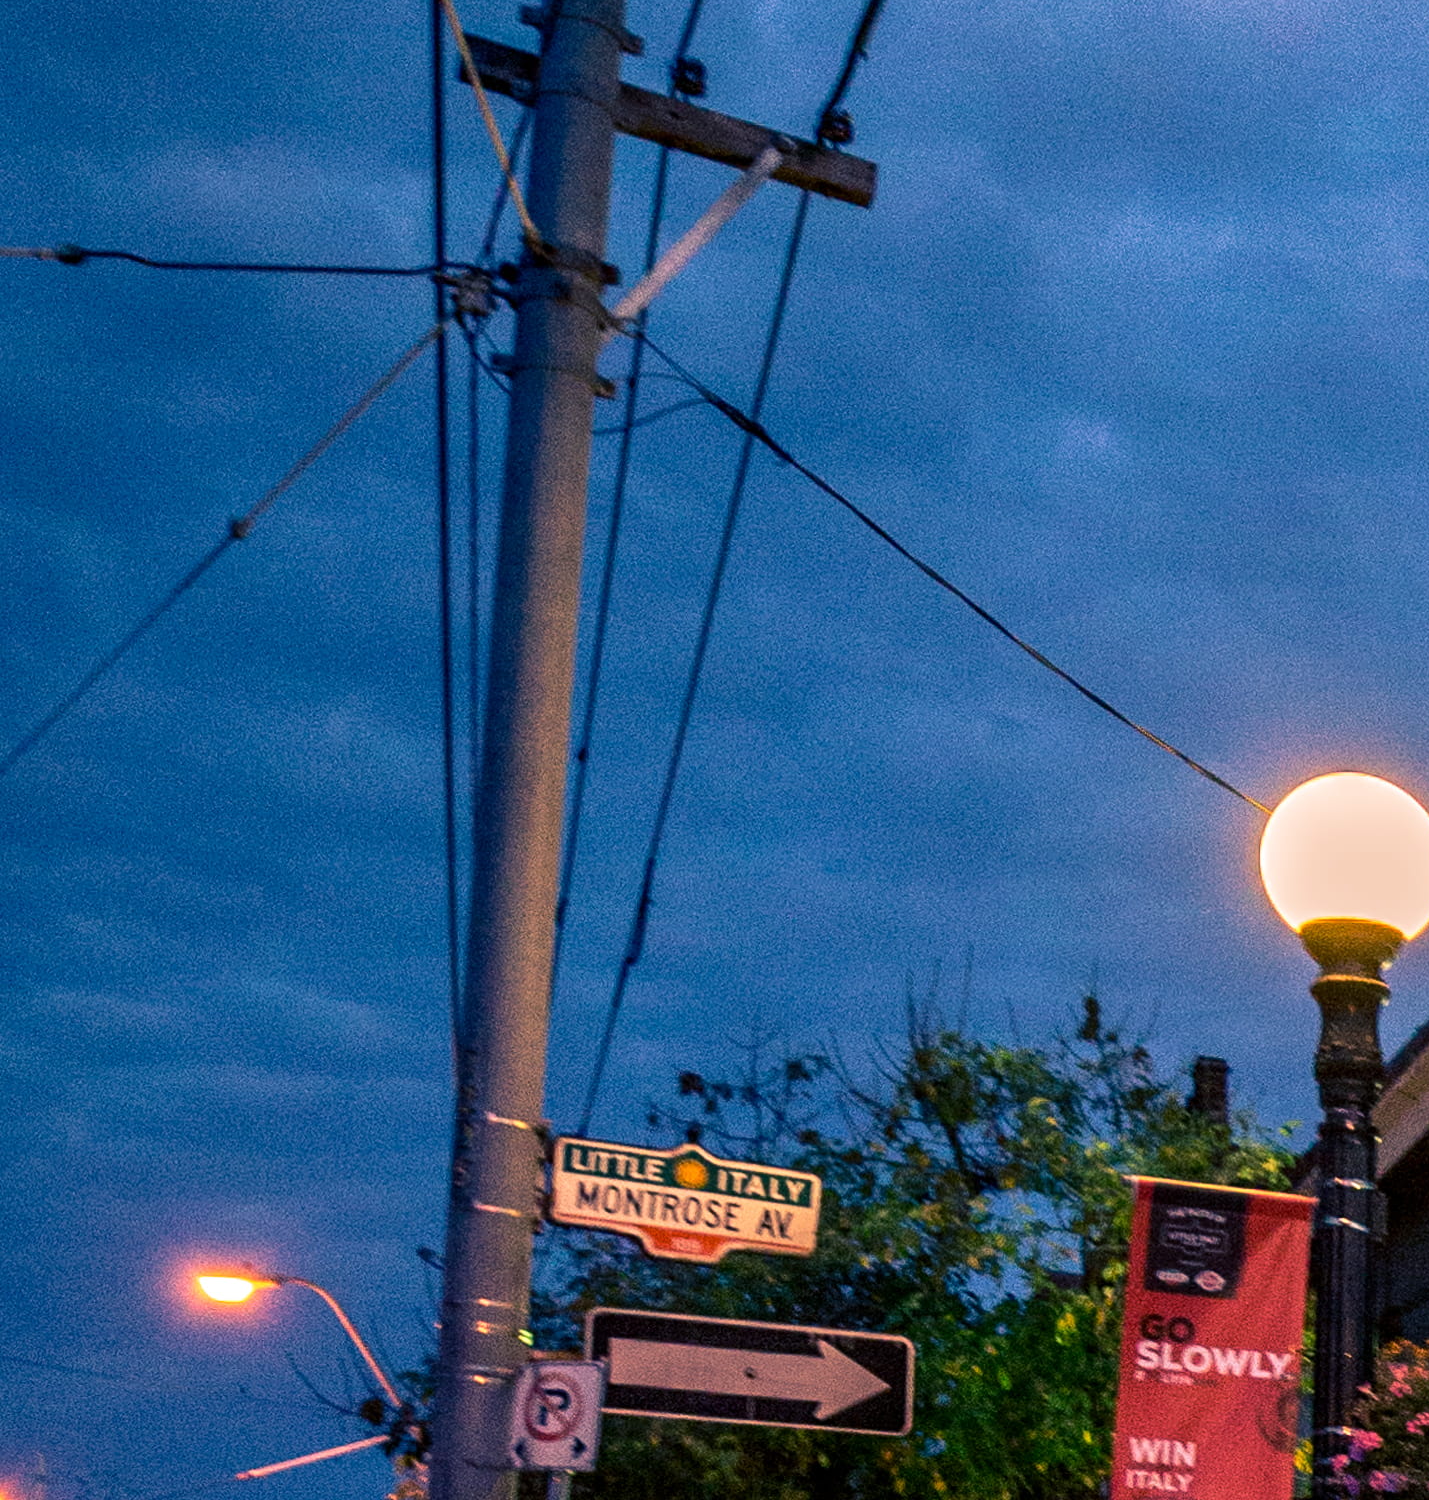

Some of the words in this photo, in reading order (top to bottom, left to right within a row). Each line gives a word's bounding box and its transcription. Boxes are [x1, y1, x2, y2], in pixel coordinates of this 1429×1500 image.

[570, 1148, 666, 1183] LITTLE
[717, 1168, 806, 1203] ITALY
[577, 1181, 741, 1233] MONTROSE
[756, 1208, 794, 1240] AV
[1139, 1313, 1196, 1344] GO
[1135, 1340, 1292, 1379] SLOWLY
[1128, 1437, 1197, 1467] WIN
[1125, 1469, 1195, 1492] ITALY
